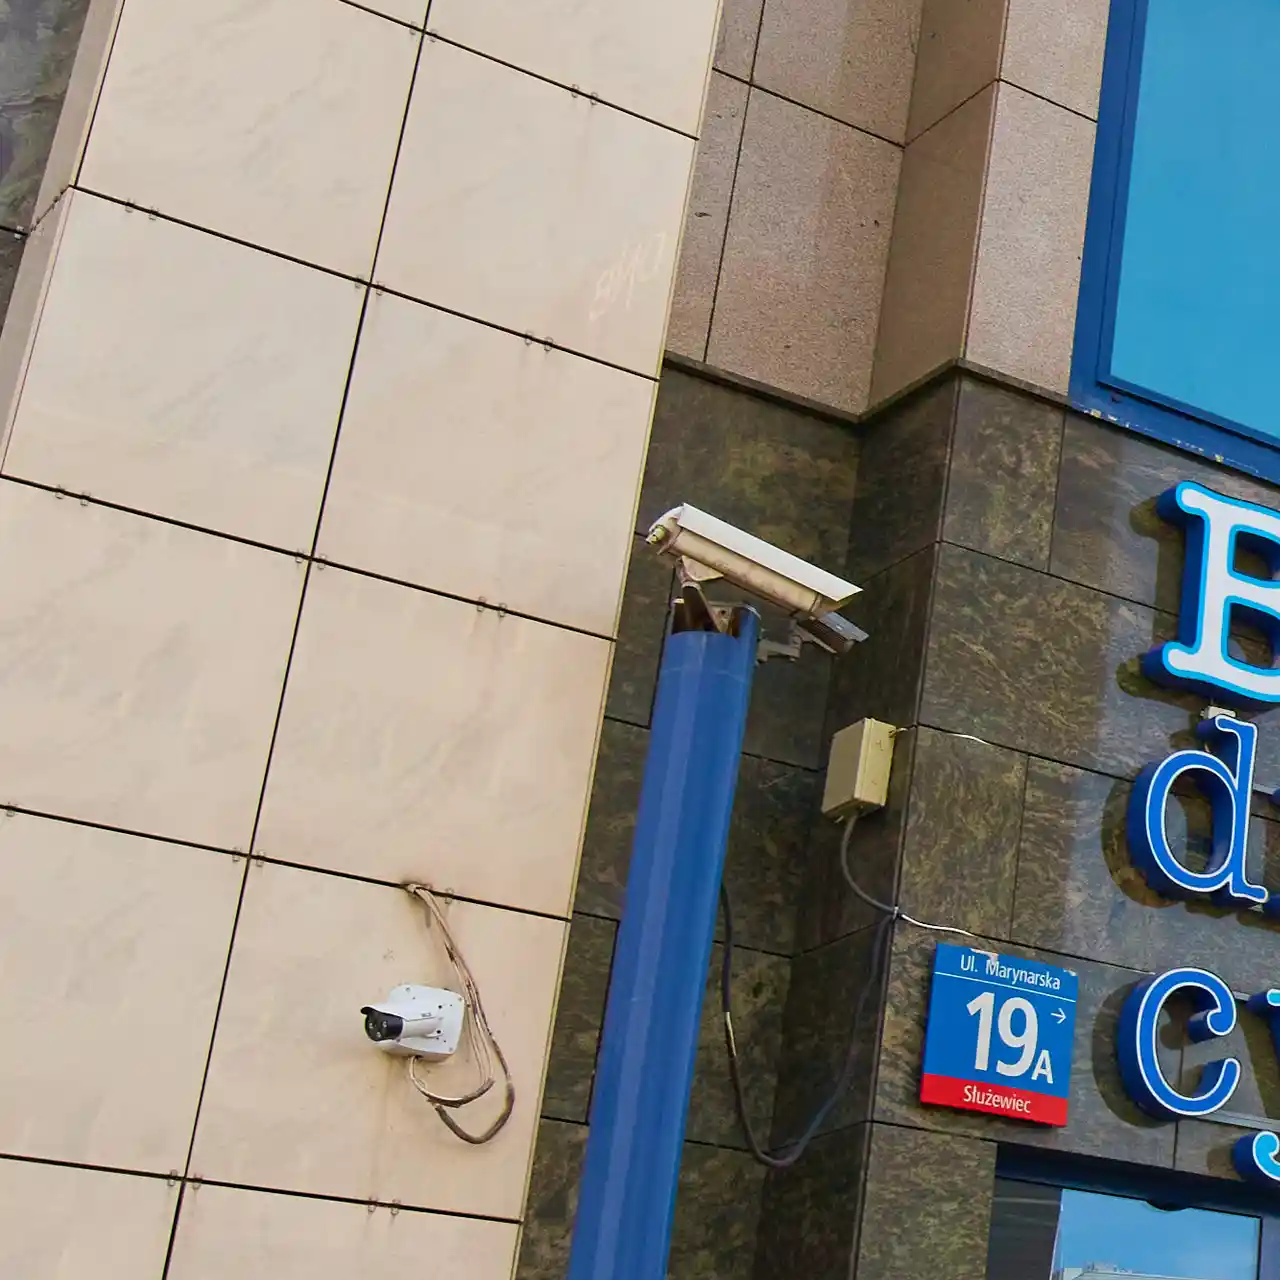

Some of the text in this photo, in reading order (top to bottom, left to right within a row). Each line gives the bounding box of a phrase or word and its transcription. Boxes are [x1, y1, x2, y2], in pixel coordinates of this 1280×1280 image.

[960, 954, 1061, 991] Ul. Marynarska
[963, 1085, 1032, 1114] Służewiec
